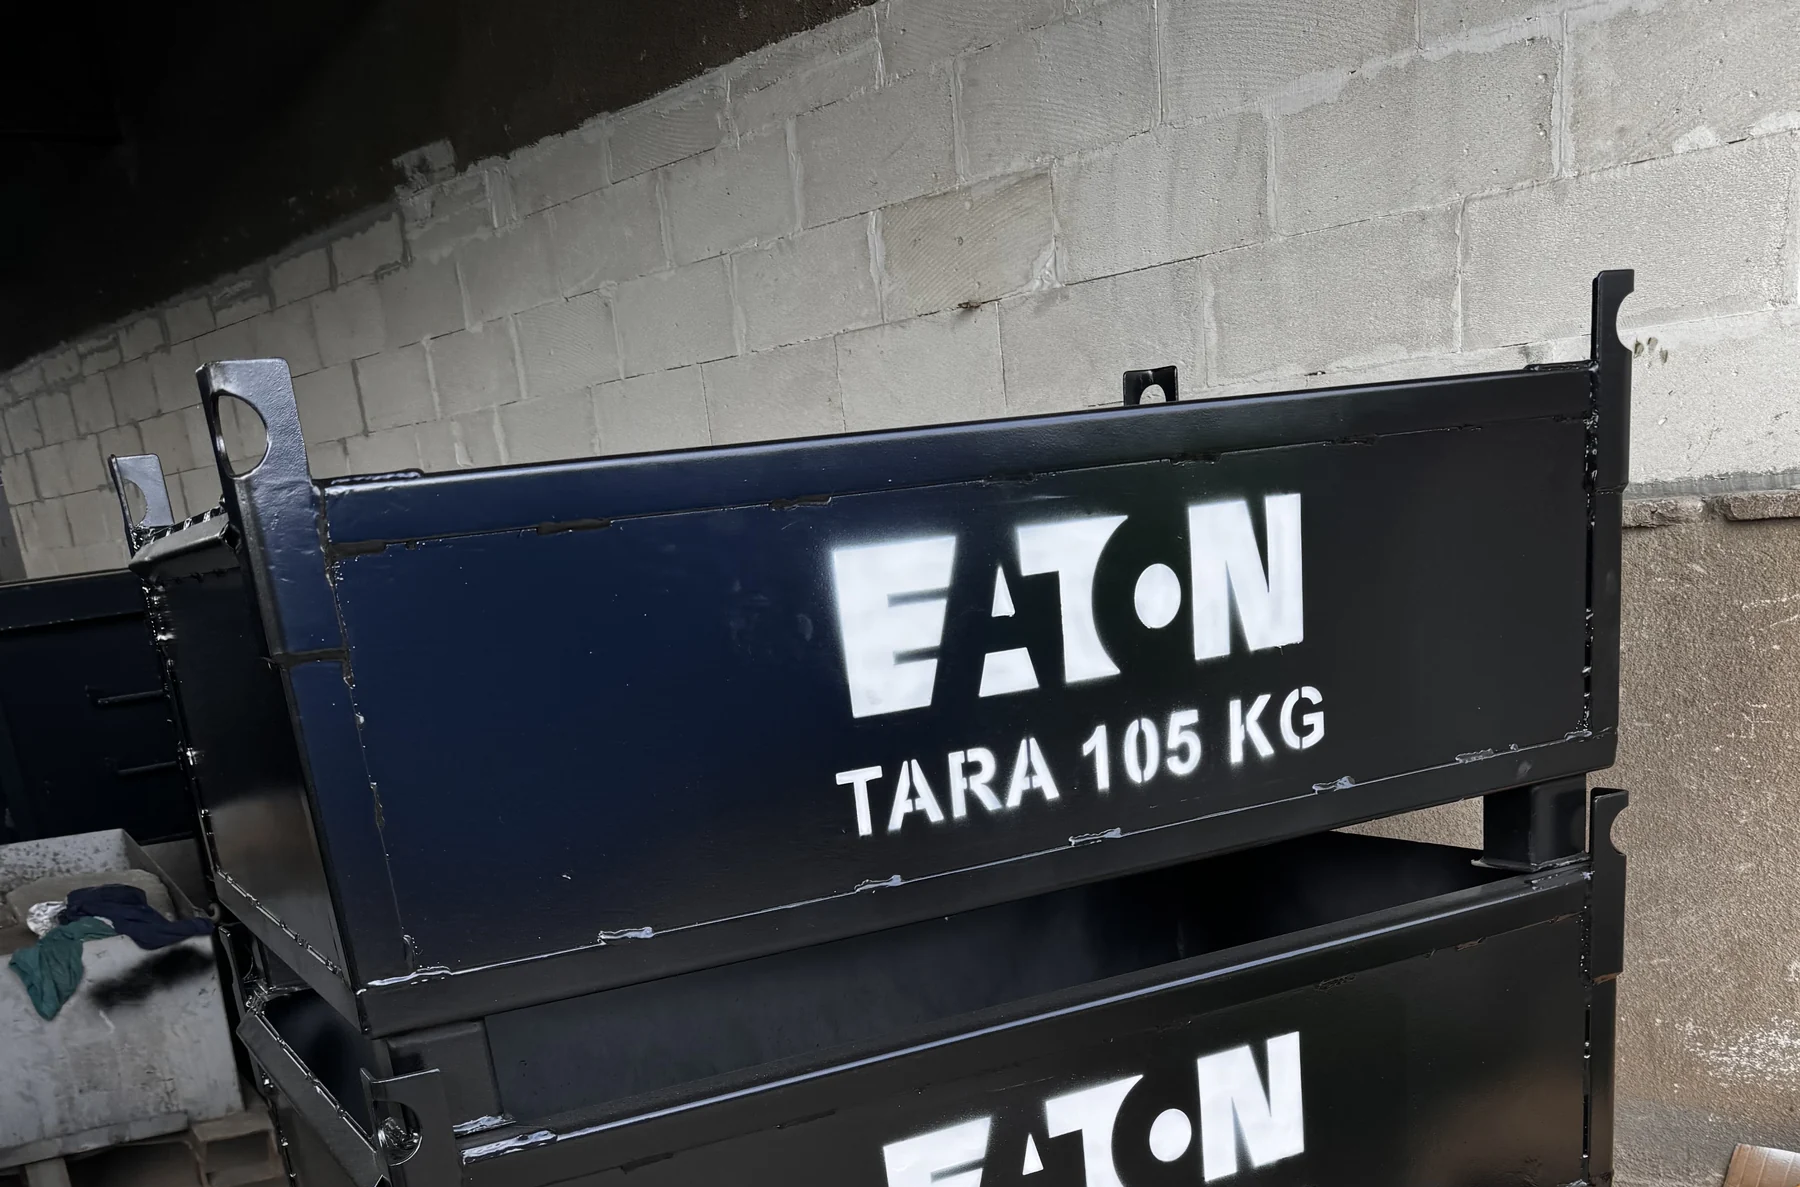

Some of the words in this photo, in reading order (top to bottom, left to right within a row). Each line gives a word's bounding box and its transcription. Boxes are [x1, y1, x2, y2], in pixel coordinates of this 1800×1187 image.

[829, 492, 1304, 719] EATON
[835, 737, 1060, 837] TARA
[1082, 708, 1203, 792] 105
[1228, 685, 1326, 766] KG
